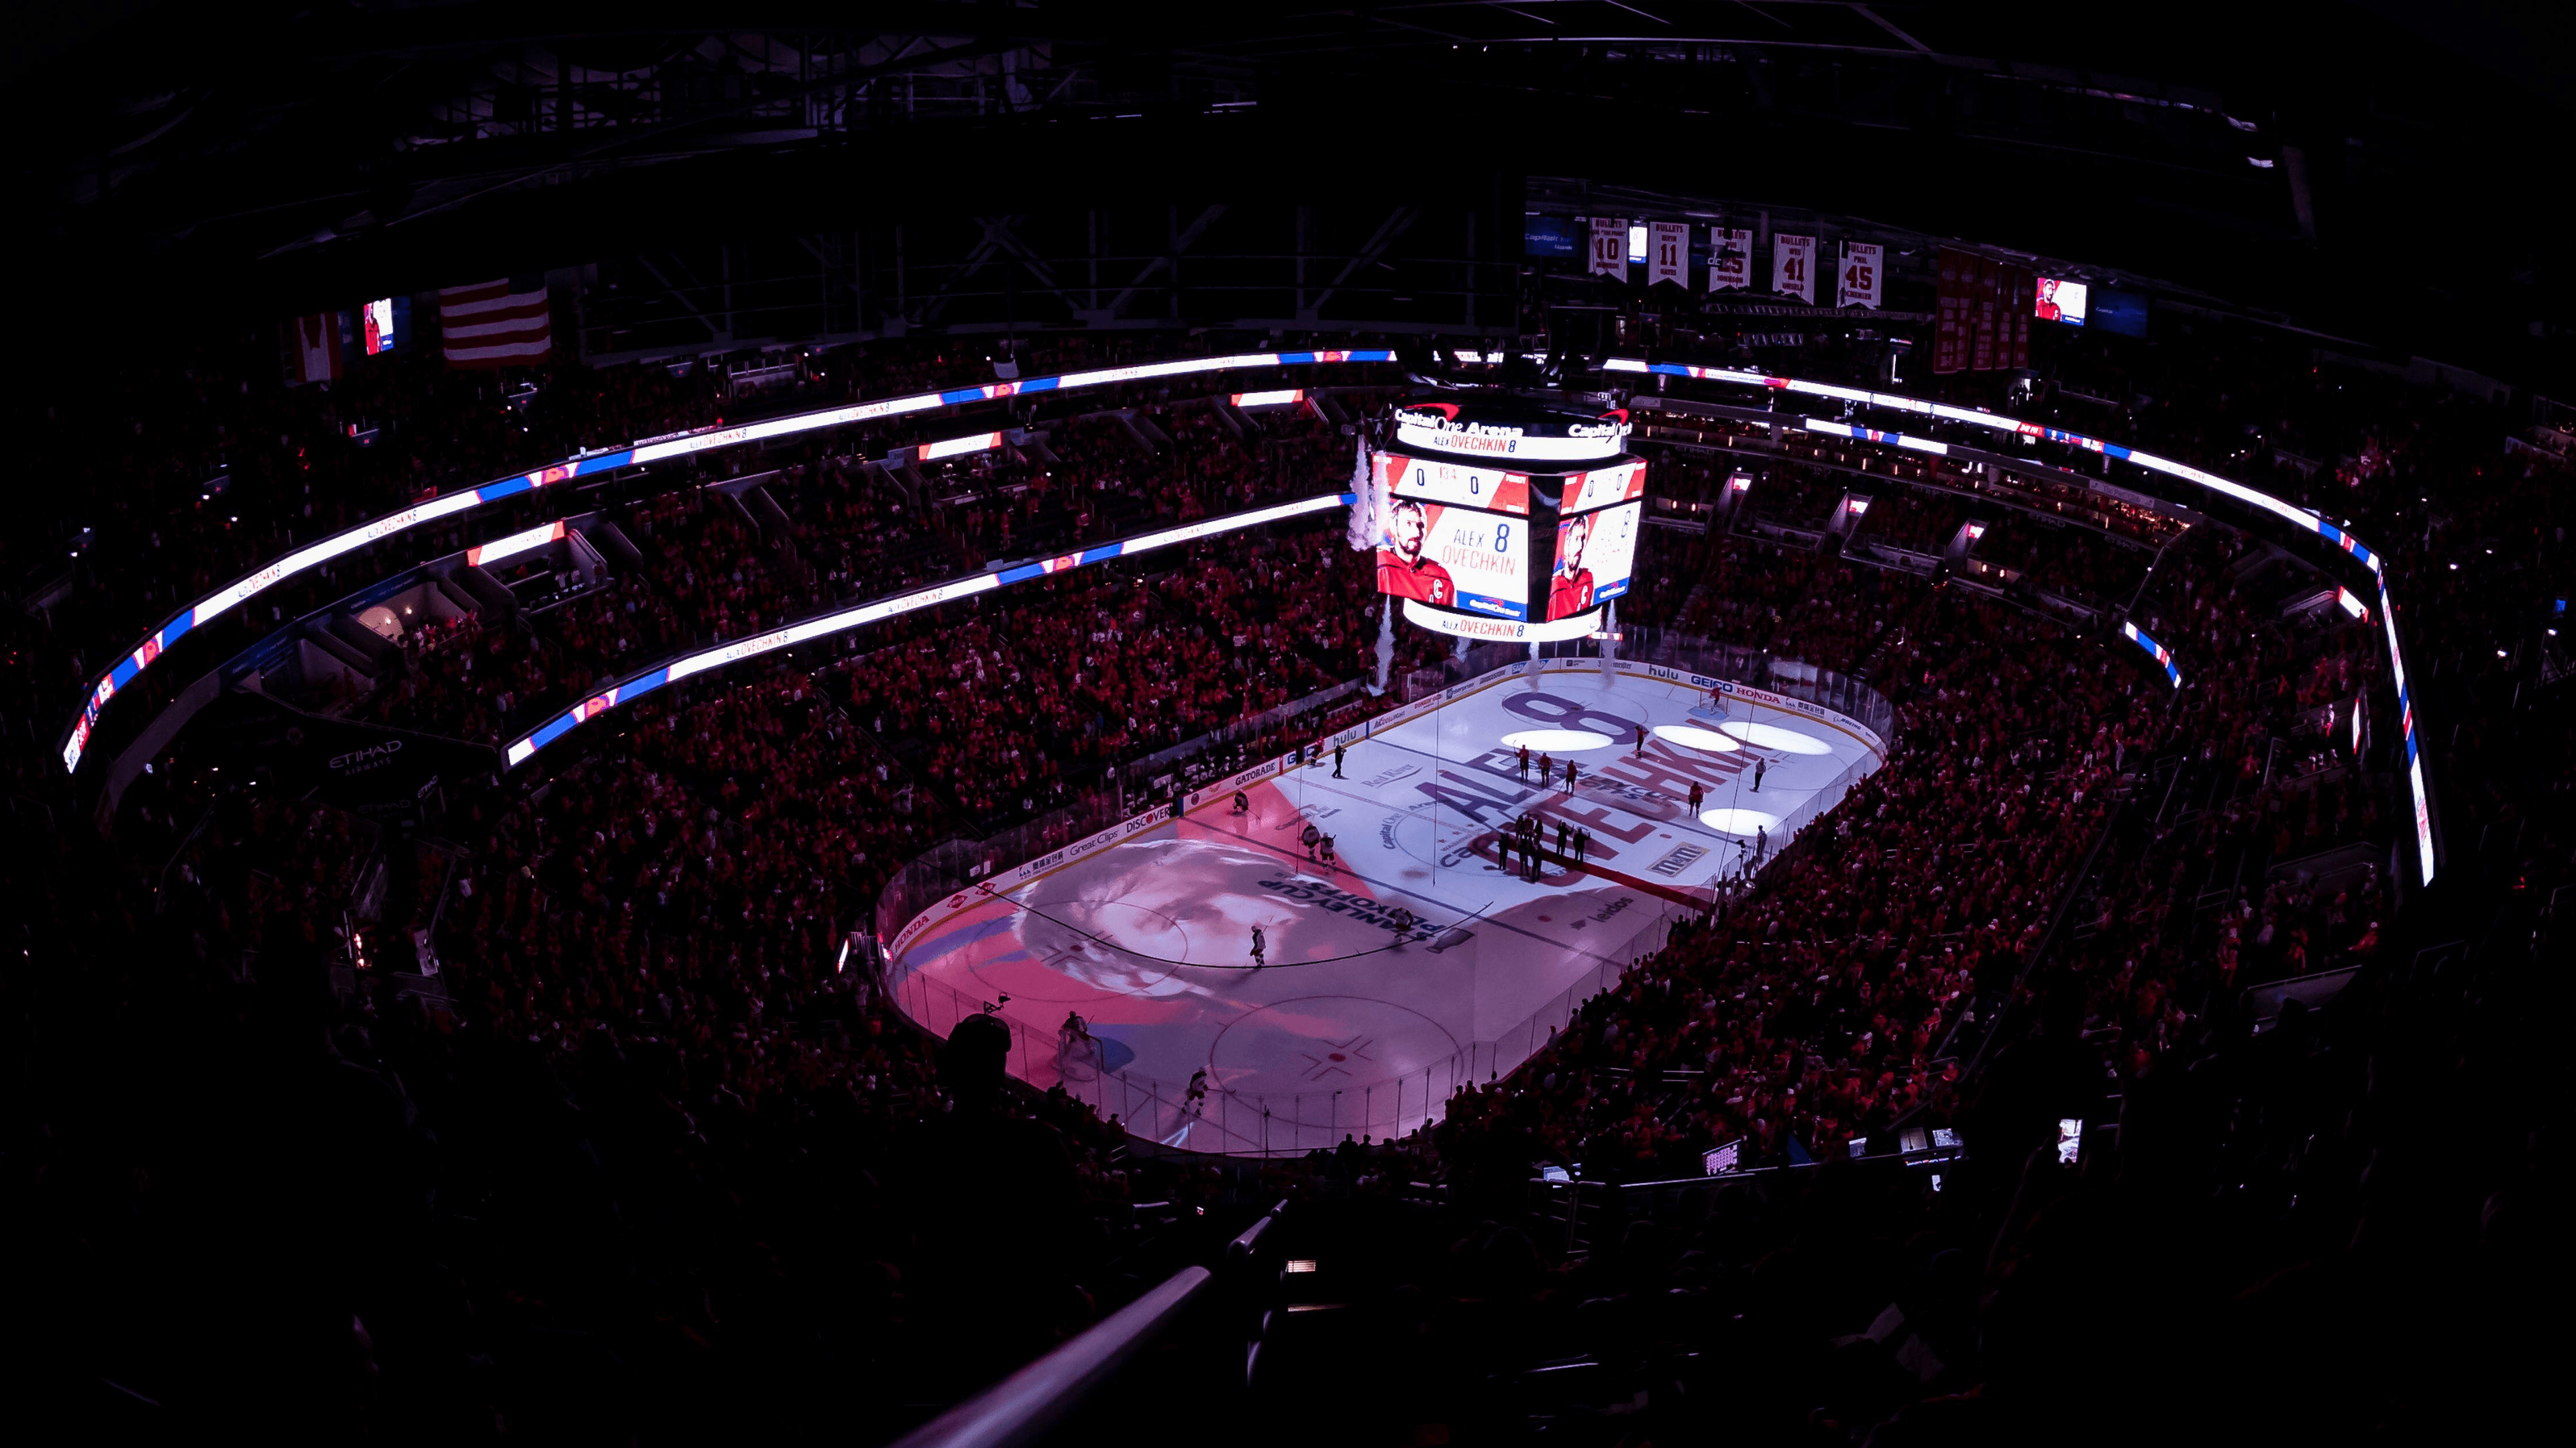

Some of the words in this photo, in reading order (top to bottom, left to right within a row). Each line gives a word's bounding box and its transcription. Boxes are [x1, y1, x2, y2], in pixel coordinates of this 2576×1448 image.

[1595, 219, 1622, 228] BULLTS
[1656, 223, 1684, 233] BULLETS
[1597, 237, 1619, 260] 10
[1780, 236, 1810, 246] BULLETS
[1849, 243, 1877, 255] ULLETS
[1660, 243, 1677, 266] 11
[1784, 258, 1805, 281] 41
[1845, 265, 1872, 290] 45
[1465, 422, 1523, 437] Arena
[1450, 435, 1507, 453] OVECHKIN
[1508, 439, 1517, 453] 8
[1416, 468, 1425, 487] 0
[1470, 476, 1479, 495] 0
[1617, 473, 1623, 492] 0
[1588, 480, 1595, 498] 0
[1621, 510, 1631, 539] 8
[1453, 528, 1485, 548] ALEX
[1494, 523, 1510, 553] 8
[1442, 545, 1516, 575] OVECHKIN
[1460, 619, 1515, 637] OVECHKIN
[1516, 624, 1525, 638] 8
[1648, 665, 1678, 680] hulu
[1690, 675, 1733, 693] GEICO
[1736, 687, 1781, 704] HONDA
[1502, 692, 1650, 744] 8
[1333, 730, 1357, 747] hulu
[329, 740, 402, 769] ETIHAD
[1235, 762, 1276, 786] GATORADE
[1126, 807, 1170, 834] DISCOVER
[1070, 840, 1095, 856] Great
[1097, 830, 1118, 844] Clips
[1587, 897, 1635, 923] leidos
[894, 915, 930, 954] HONDA
